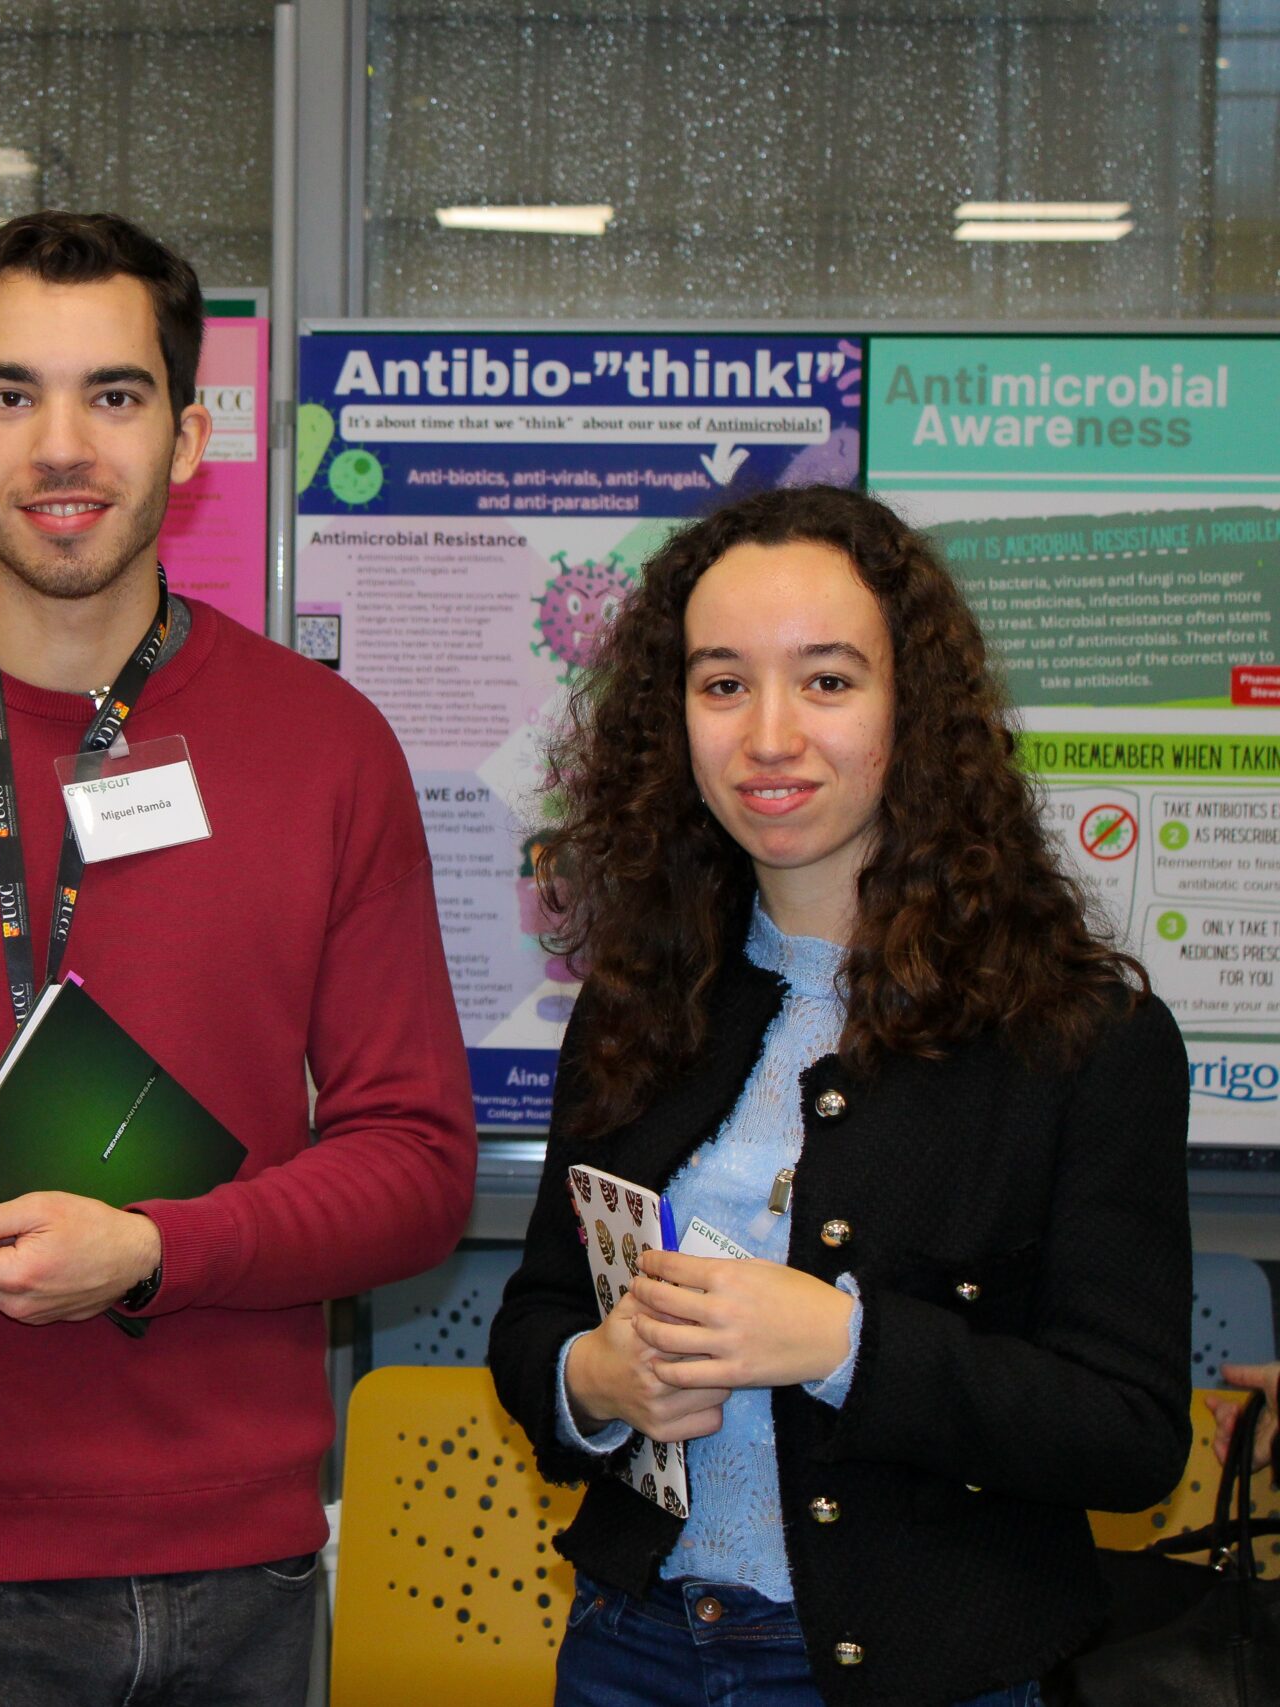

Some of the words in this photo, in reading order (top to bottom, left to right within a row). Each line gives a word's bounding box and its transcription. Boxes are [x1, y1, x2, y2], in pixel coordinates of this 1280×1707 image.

[884, 362, 1228, 408] Antimicrobial
[348, 415, 370, 429] It's
[376, 415, 416, 429] about
[421, 415, 455, 429] time
[460, 415, 489, 429] that
[494, 418, 514, 429] we
[582, 417, 623, 430] about
[628, 420, 654, 430] our
[659, 420, 683, 430] use
[687, 417, 703, 430] of
[705, 418, 824, 434] Antimicrobials!
[912, 404, 1192, 448] Awareness
[407, 468, 510, 488] Anti-biotics,
[513, 468, 602, 488] anti-virals,
[606, 468, 711, 490] anti-fungals,
[477, 494, 510, 509] and
[513, 494, 640, 513] anti-parasitics!
[311, 531, 429, 547] Antimicrobial
[434, 532, 528, 548] Resistance
[984, 535, 1002, 560] IS
[1092, 523, 1191, 552] RESISTANCE
[1195, 522, 1208, 547] A
[1211, 518, 1280, 547] PROBLE
[989, 576, 1051, 592] bacteria,
[1054, 575, 1105, 590] viruses
[1107, 572, 1135, 588] and
[1138, 570, 1175, 590] fungi
[1177, 573, 1196, 585] no
[1198, 570, 1245, 588] longer
[991, 597, 1007, 611] to
[1010, 595, 1087, 612] medicines,
[1089, 592, 1160, 609] infections
[1163, 590, 1221, 606] become
[1223, 592, 1263, 605] more
[998, 617, 1038, 630] treat.
[1040, 612, 1108, 630] Microbial
[1110, 611, 1183, 628] resistance
[1186, 609, 1225, 625] often
[1228, 609, 1272, 624] stems
[1030, 638, 1056, 651] use
[1059, 634, 1075, 649] of
[1076, 631, 1182, 649] antimicrobials.
[1185, 628, 1257, 646] Therefore
[1258, 628, 1271, 644] it
[1037, 654, 1050, 669] is
[1052, 651, 1124, 669] conscious
[1126, 650, 1143, 667] of
[1145, 649, 1169, 666] the
[1171, 649, 1224, 666] correct
[1227, 650, 1257, 667] way
[1259, 648, 1276, 664] to
[1040, 674, 1072, 690] take
[1074, 671, 1153, 690] antibiotics.
[1239, 673, 1280, 687] Pharma
[93, 715, 122, 750] UCC
[1064, 741, 1165, 771] REMEMBER
[1171, 743, 1223, 771] WHEN
[423, 786, 452, 802] WE
[100, 805, 136, 822] Miguel
[136, 798, 173, 815] Ramôa
[1162, 801, 1193, 819] TAKE
[1195, 801, 1269, 821] ANTIBIOTICS
[1194, 826, 1211, 844] AS
[1213, 826, 1280, 846] PRESCRIBE
[1157, 856, 1234, 870] Remember
[1237, 856, 1251, 870] to
[1255, 856, 1280, 870] finis
[1178, 878, 1239, 891] antibiotic
[1243, 880, 1280, 892] cours
[0, 883, 17, 921] UCC
[1202, 919, 1235, 938] ONLY
[1239, 919, 1269, 938] TAKE
[1179, 943, 1240, 962] MEDICINES
[1242, 944, 1280, 963] PRESC
[1219, 969, 1245, 988] FOR
[1249, 969, 1274, 988] YOU
[1191, 998, 1229, 1012] share
[1233, 999, 1263, 1016] your
[506, 1065, 550, 1088] Áine
[1189, 1054, 1279, 1101] rrigo
[523, 1094, 554, 1106] Pharm
